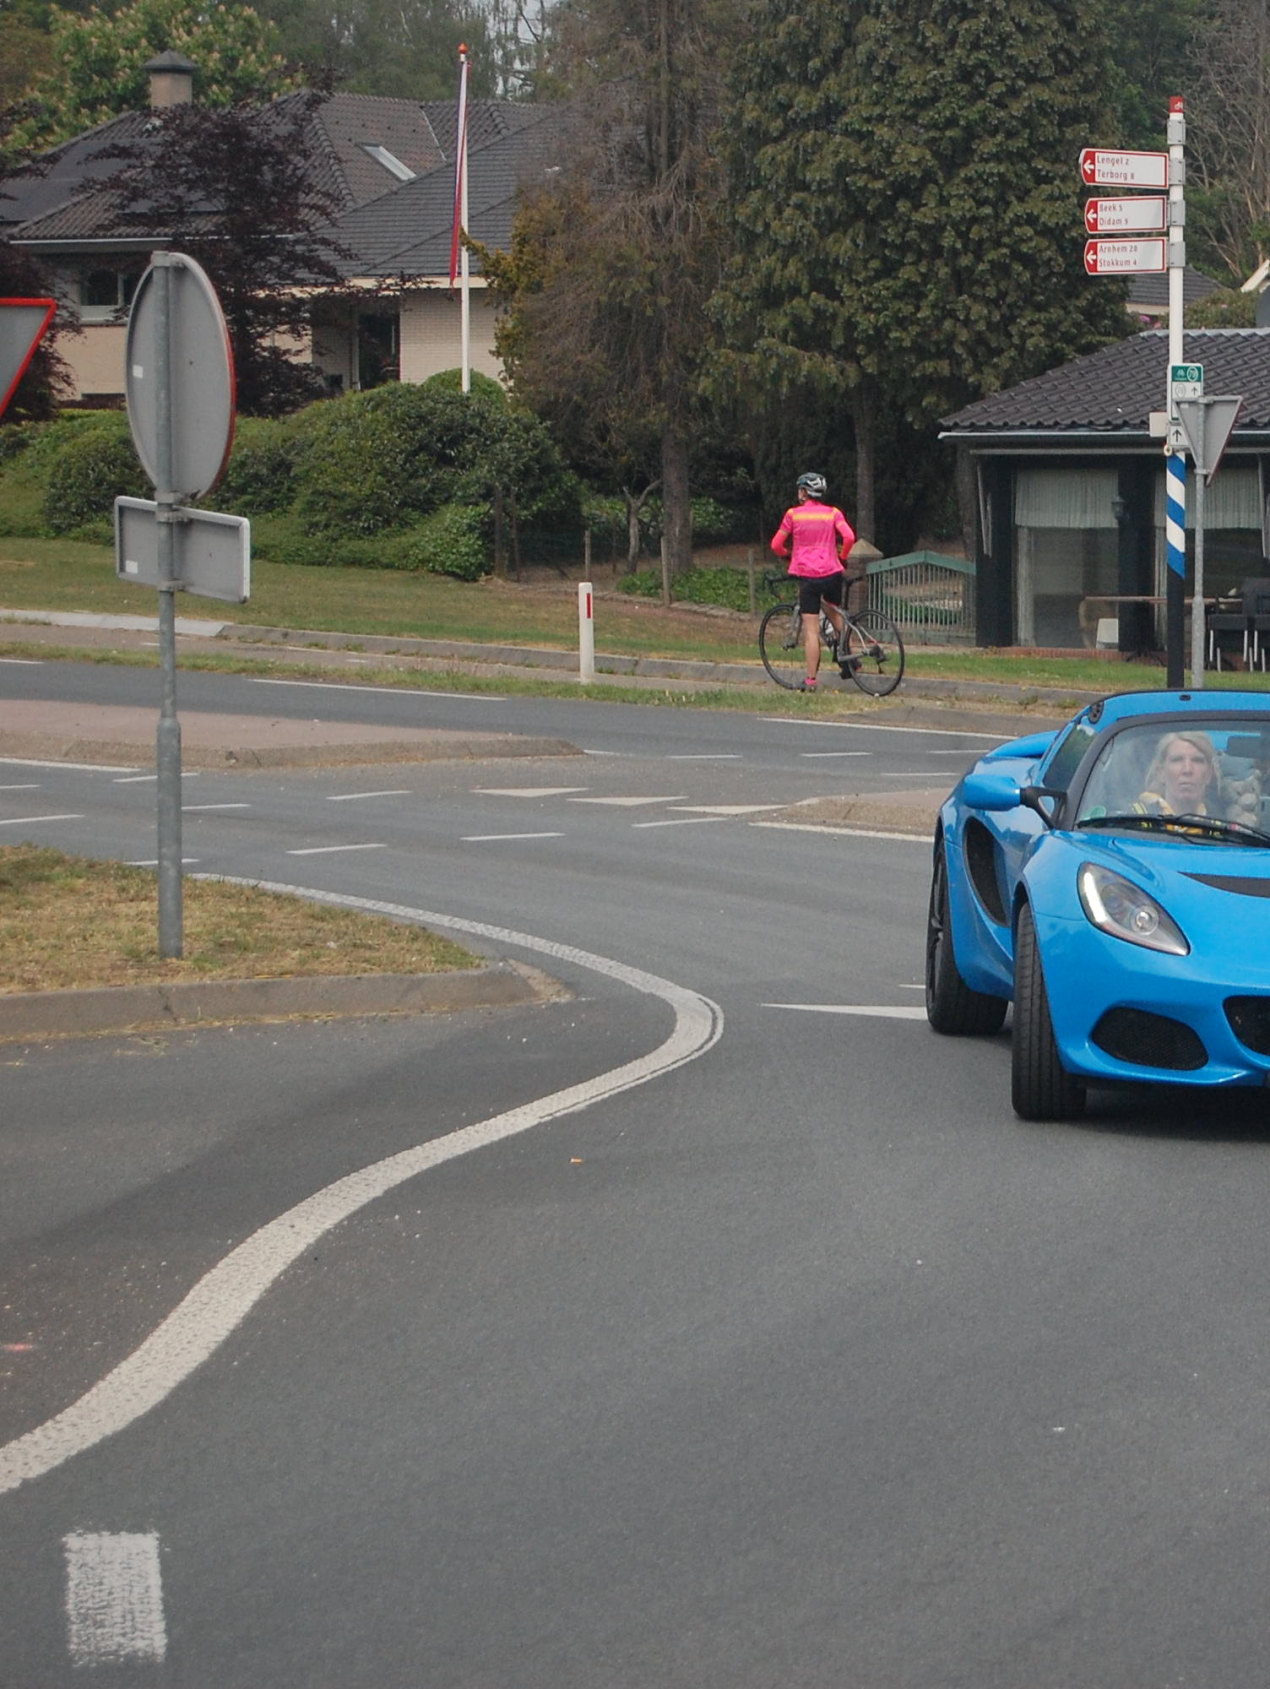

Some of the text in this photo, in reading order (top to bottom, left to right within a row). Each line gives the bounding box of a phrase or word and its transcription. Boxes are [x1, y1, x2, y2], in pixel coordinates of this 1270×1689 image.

[1097, 169, 1128, 181] Terborg
[1099, 217, 1122, 226] Didam
[1099, 244, 1128, 253] Arnhem
[1099, 258, 1131, 267] Stokkum
